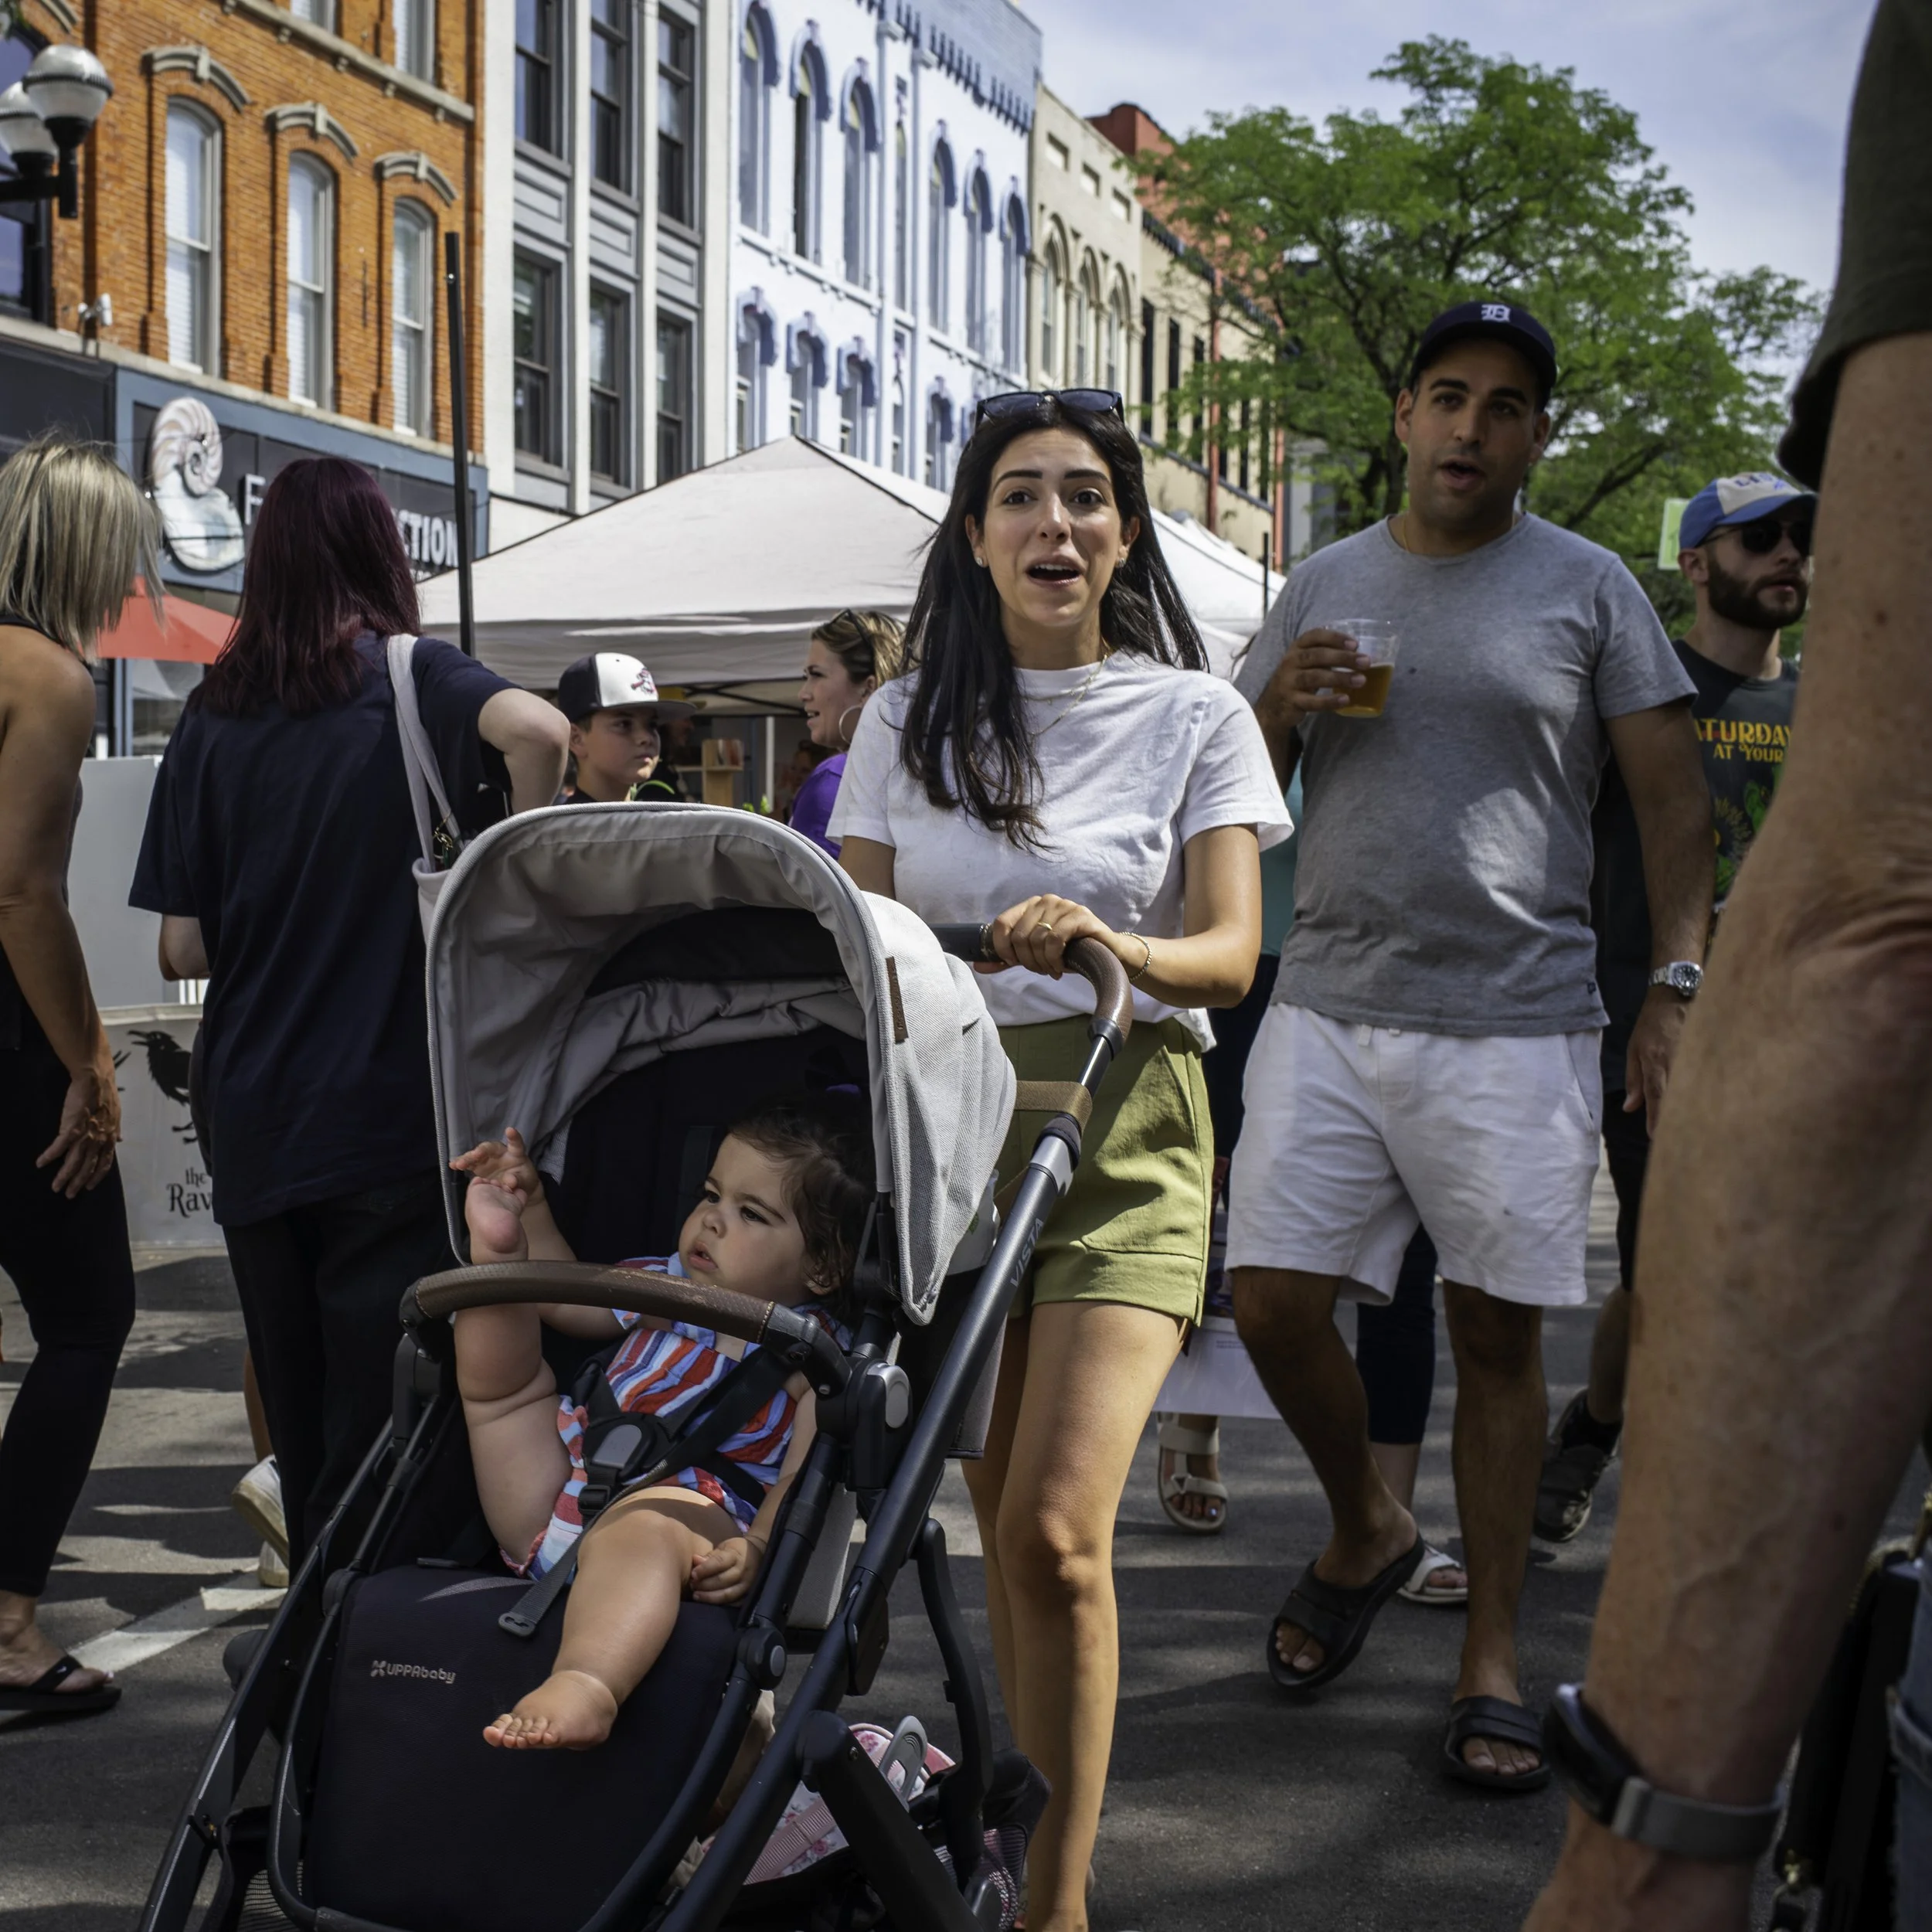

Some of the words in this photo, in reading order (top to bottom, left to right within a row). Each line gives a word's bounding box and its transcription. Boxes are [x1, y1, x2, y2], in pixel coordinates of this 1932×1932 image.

[1481, 304, 1512, 322] D
[1713, 743, 1734, 760] AT
[1738, 743, 1784, 764] YOUR
[185, 1167, 207, 1188] the
[1010, 1218, 1044, 1287] VISTA
[386, 1663, 457, 1685] UPPAbaby
